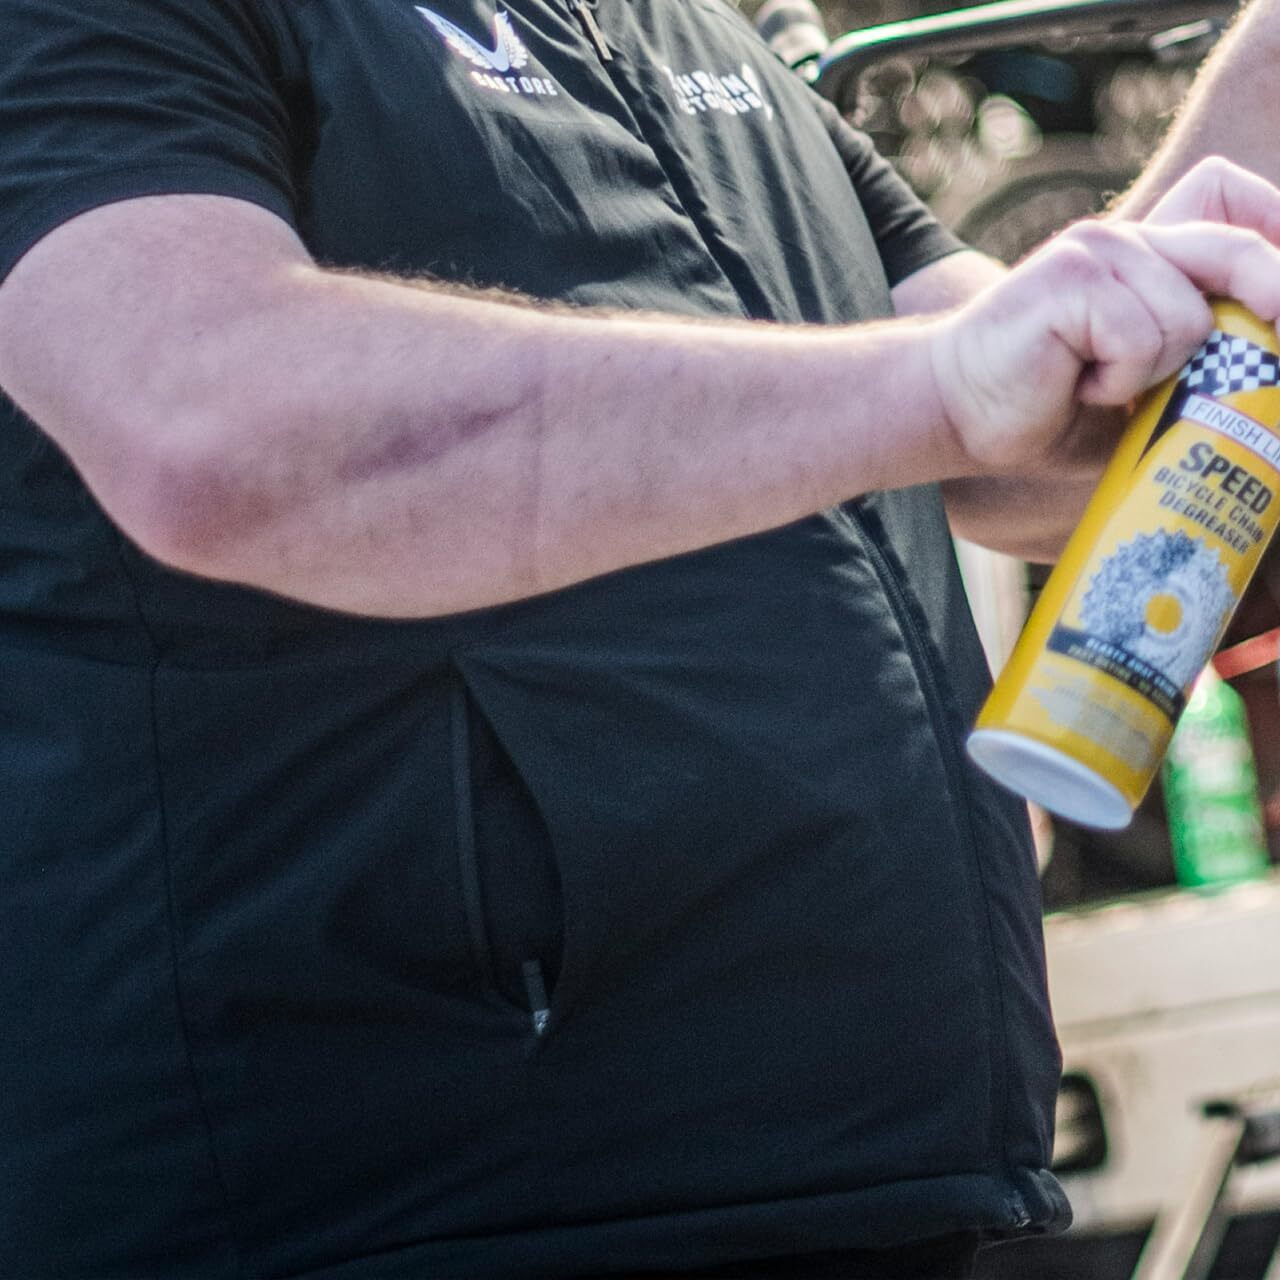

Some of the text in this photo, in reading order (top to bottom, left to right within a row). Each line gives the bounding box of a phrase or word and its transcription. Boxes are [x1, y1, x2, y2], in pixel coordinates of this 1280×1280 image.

[1191, 400, 1263, 446] FINISH
[1153, 466, 1266, 544] BICYCLE CHAIN
[1178, 441, 1274, 516] SPEED
[1158, 489, 1251, 555] DEGREASER
